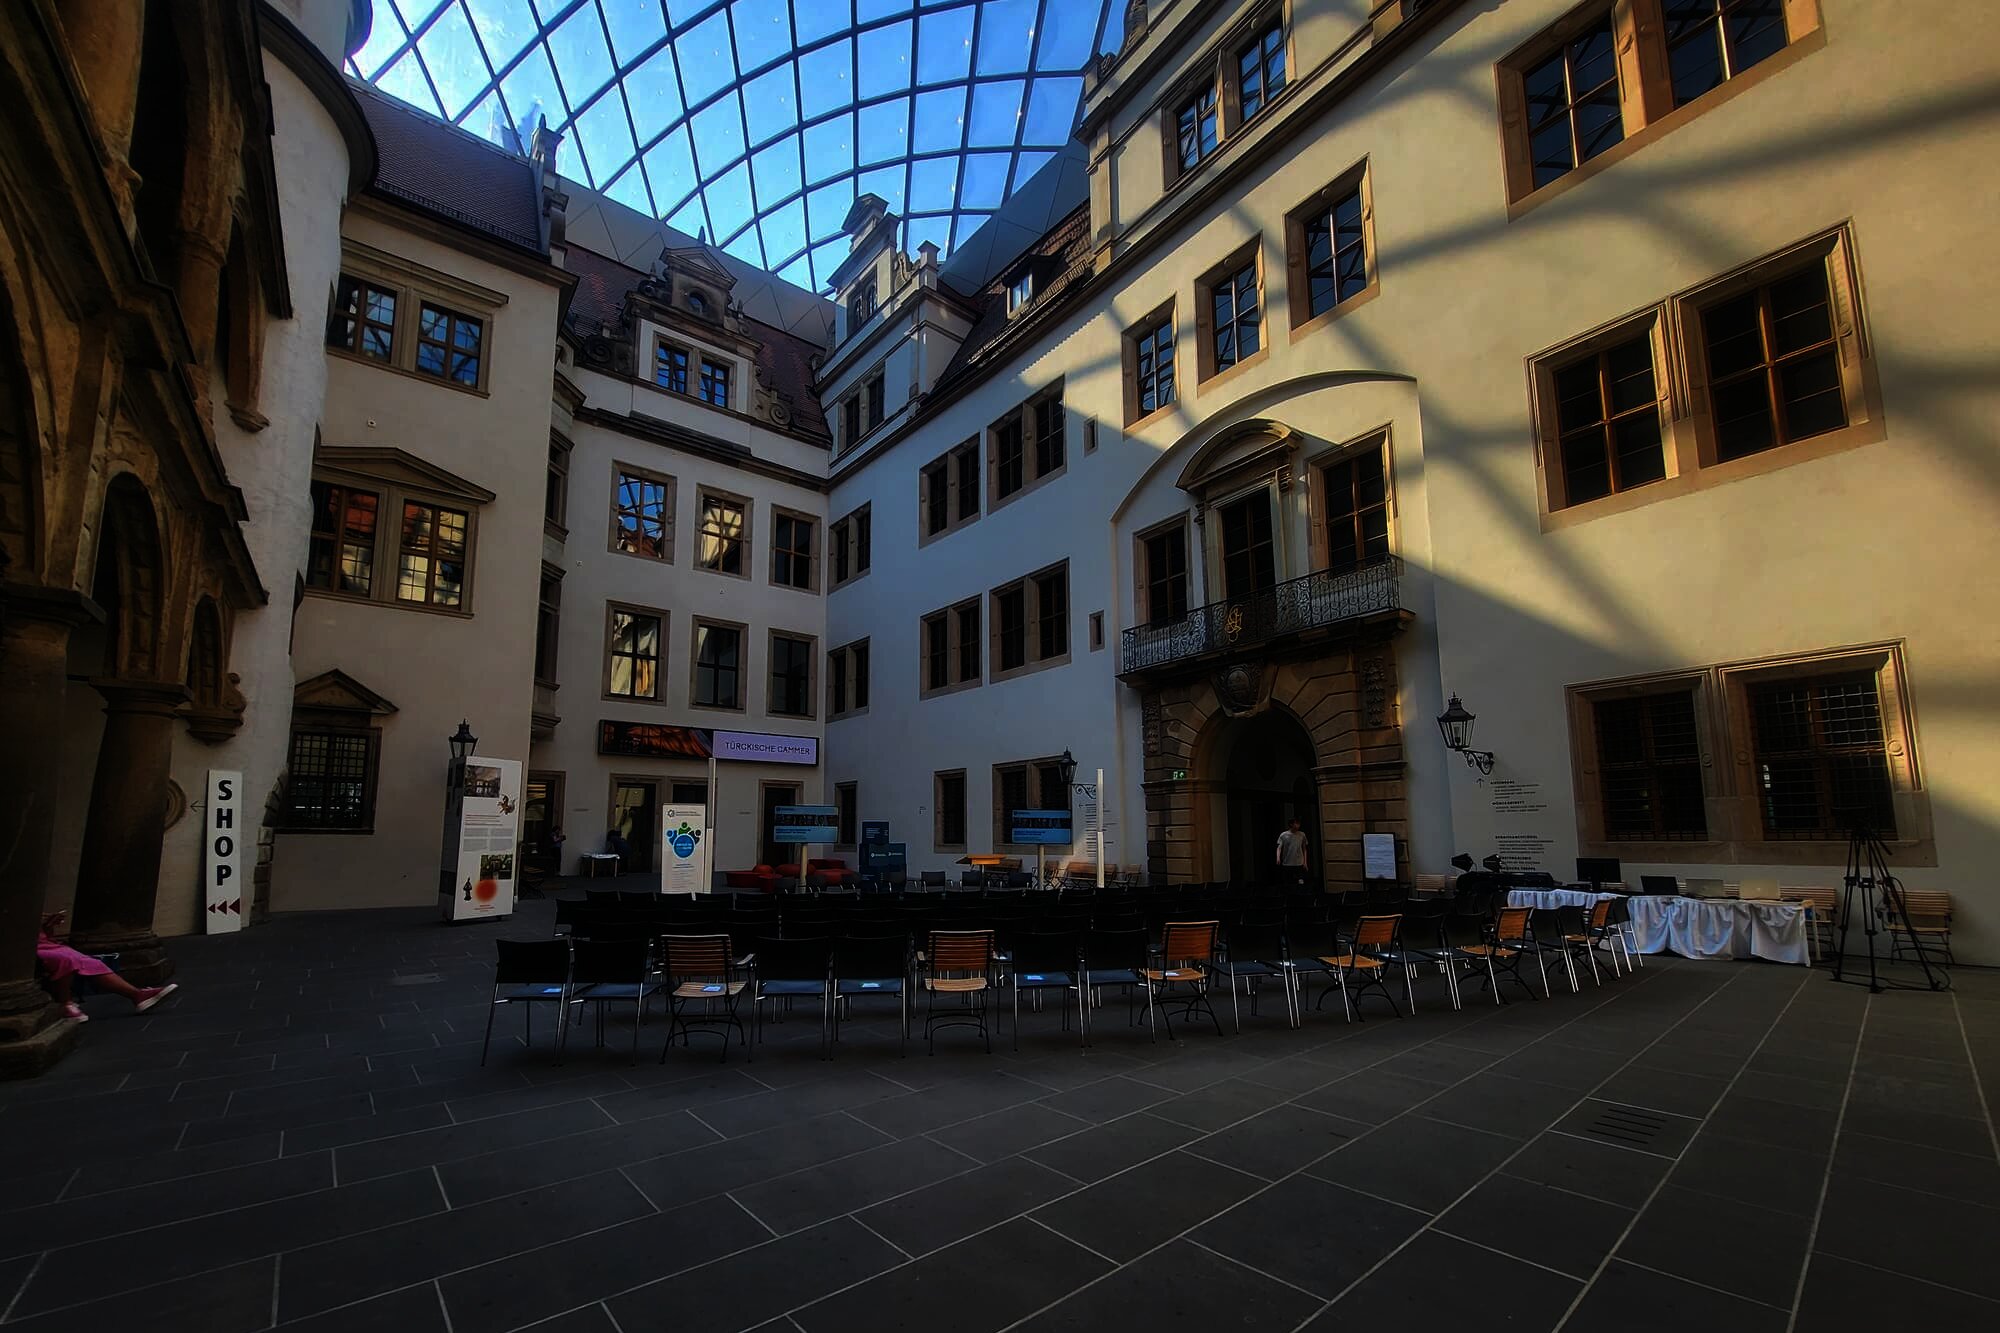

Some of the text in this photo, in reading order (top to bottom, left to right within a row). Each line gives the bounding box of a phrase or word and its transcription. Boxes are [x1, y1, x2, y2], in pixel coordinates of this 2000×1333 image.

[725, 741, 810, 755] TÜRCKISCHE CAMMER
[214, 779, 233, 886] SHOP
